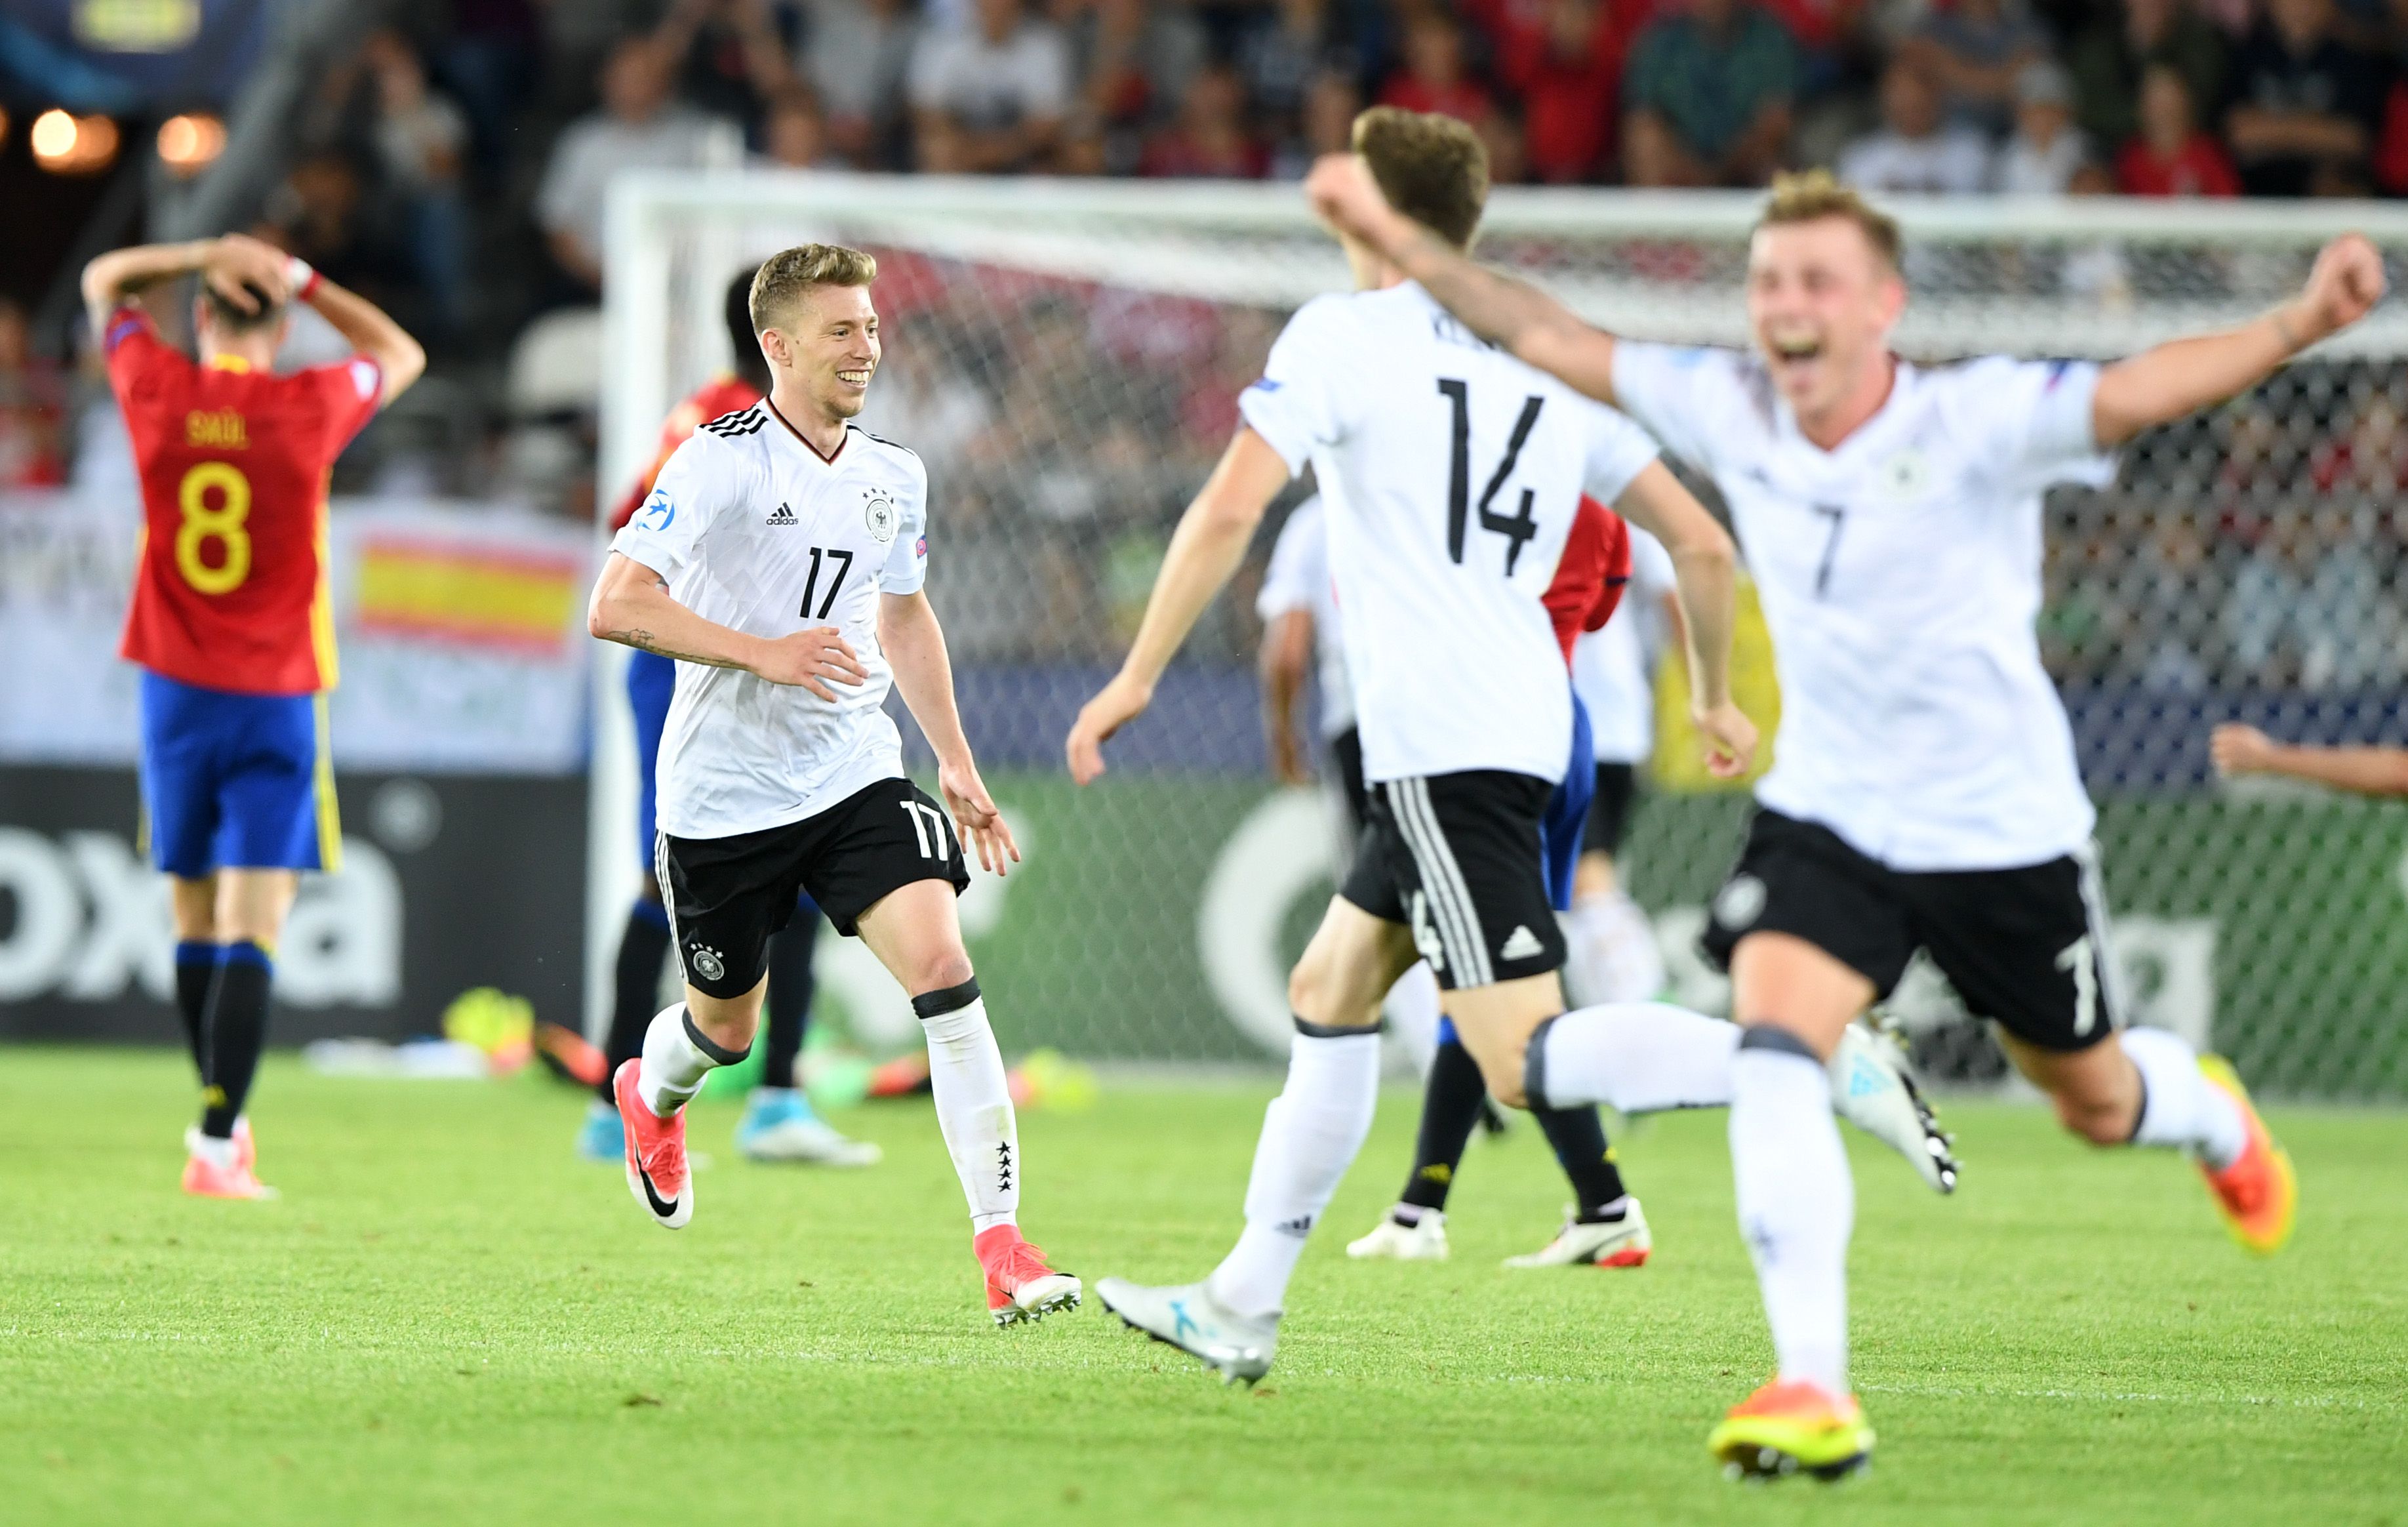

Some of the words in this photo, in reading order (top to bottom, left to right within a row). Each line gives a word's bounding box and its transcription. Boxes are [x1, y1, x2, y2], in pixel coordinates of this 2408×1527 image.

[766, 516, 799, 525] adidas
[1437, 378, 1544, 577] 14
[175, 461, 251, 596] 8
[1810, 502, 1847, 602] 7
[799, 546, 853, 620] 17
[899, 800, 949, 861] 17
